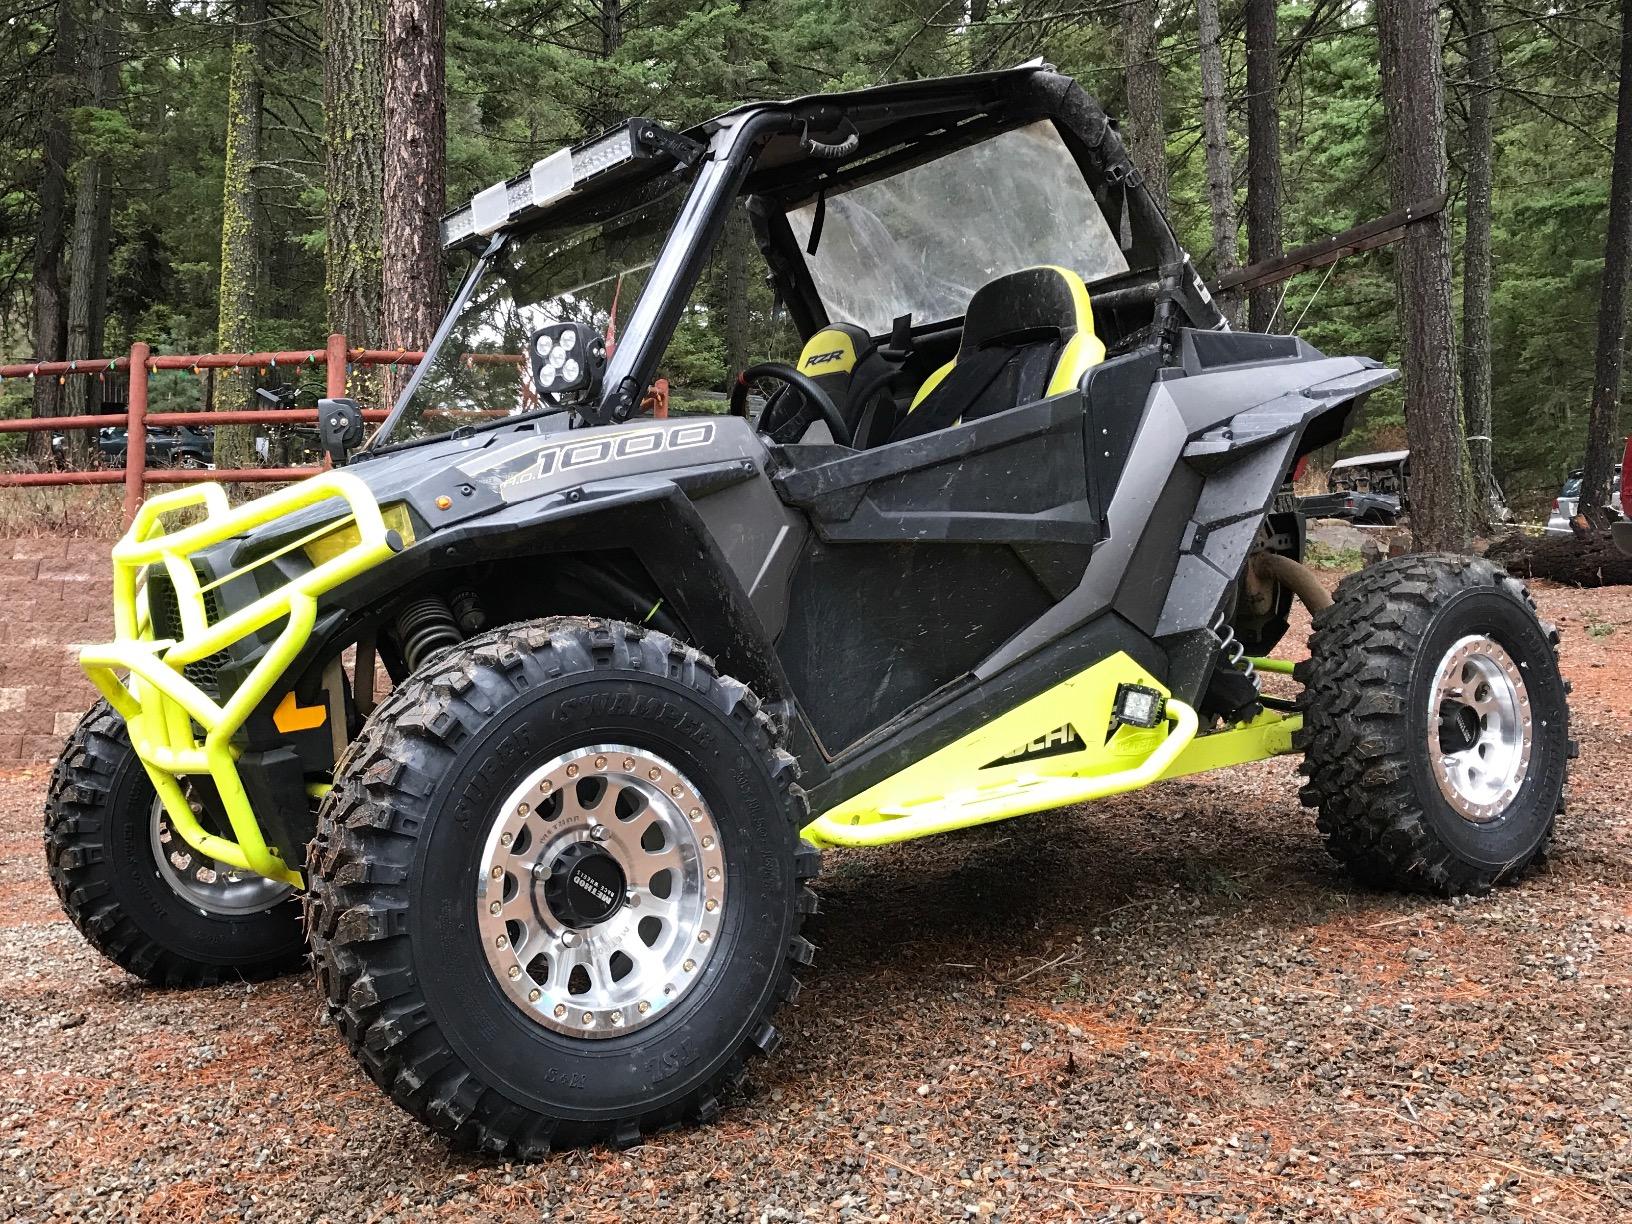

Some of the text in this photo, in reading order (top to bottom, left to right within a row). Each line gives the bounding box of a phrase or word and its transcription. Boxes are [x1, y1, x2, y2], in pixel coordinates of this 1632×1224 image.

[805, 349, 845, 369] RZR
[537, 422, 717, 481] 1000
[455, 694, 719, 832] SUPER SWAMPER
[573, 875, 612, 905] METHOD
